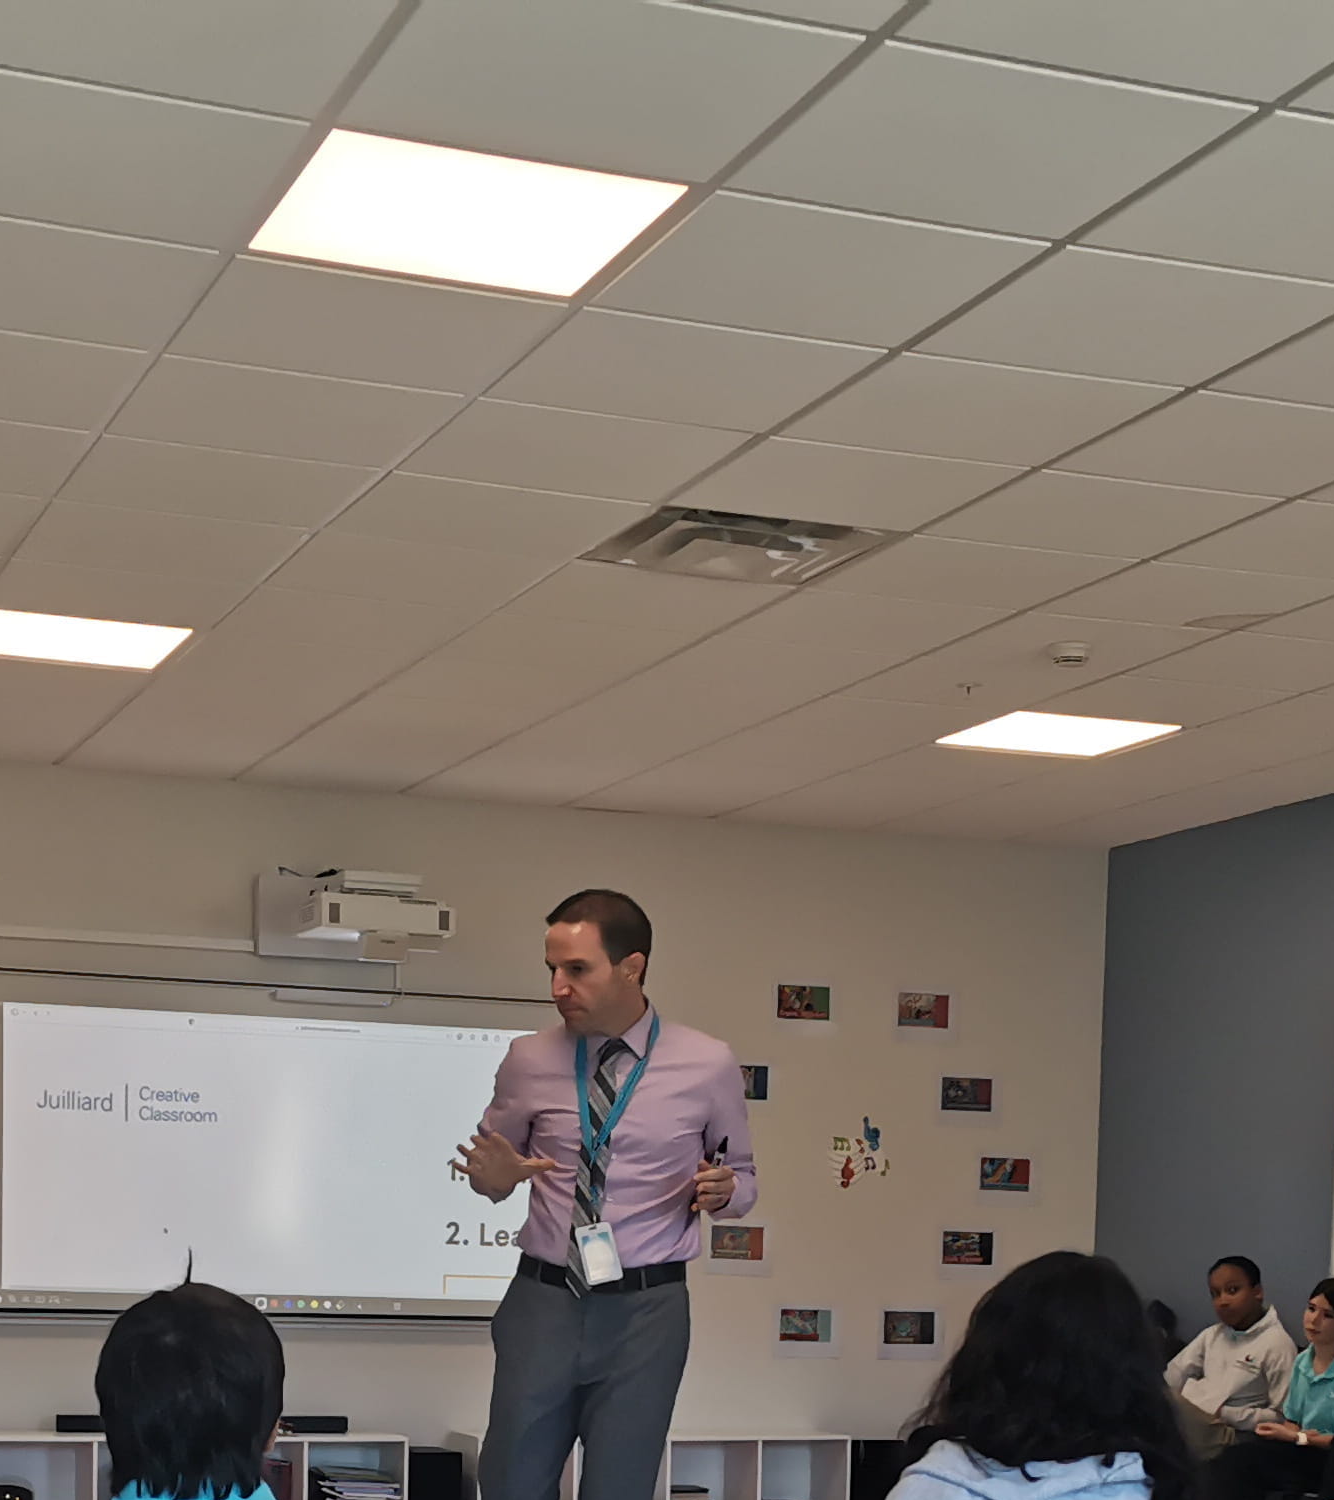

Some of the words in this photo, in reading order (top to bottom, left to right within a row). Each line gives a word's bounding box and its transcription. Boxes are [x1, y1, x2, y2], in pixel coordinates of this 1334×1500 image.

[36, 1089, 113, 1112] Juilliard
[138, 1086, 200, 1103] Creative
[138, 1106, 218, 1123] Classroom
[445, 1221, 469, 1245] 2.
